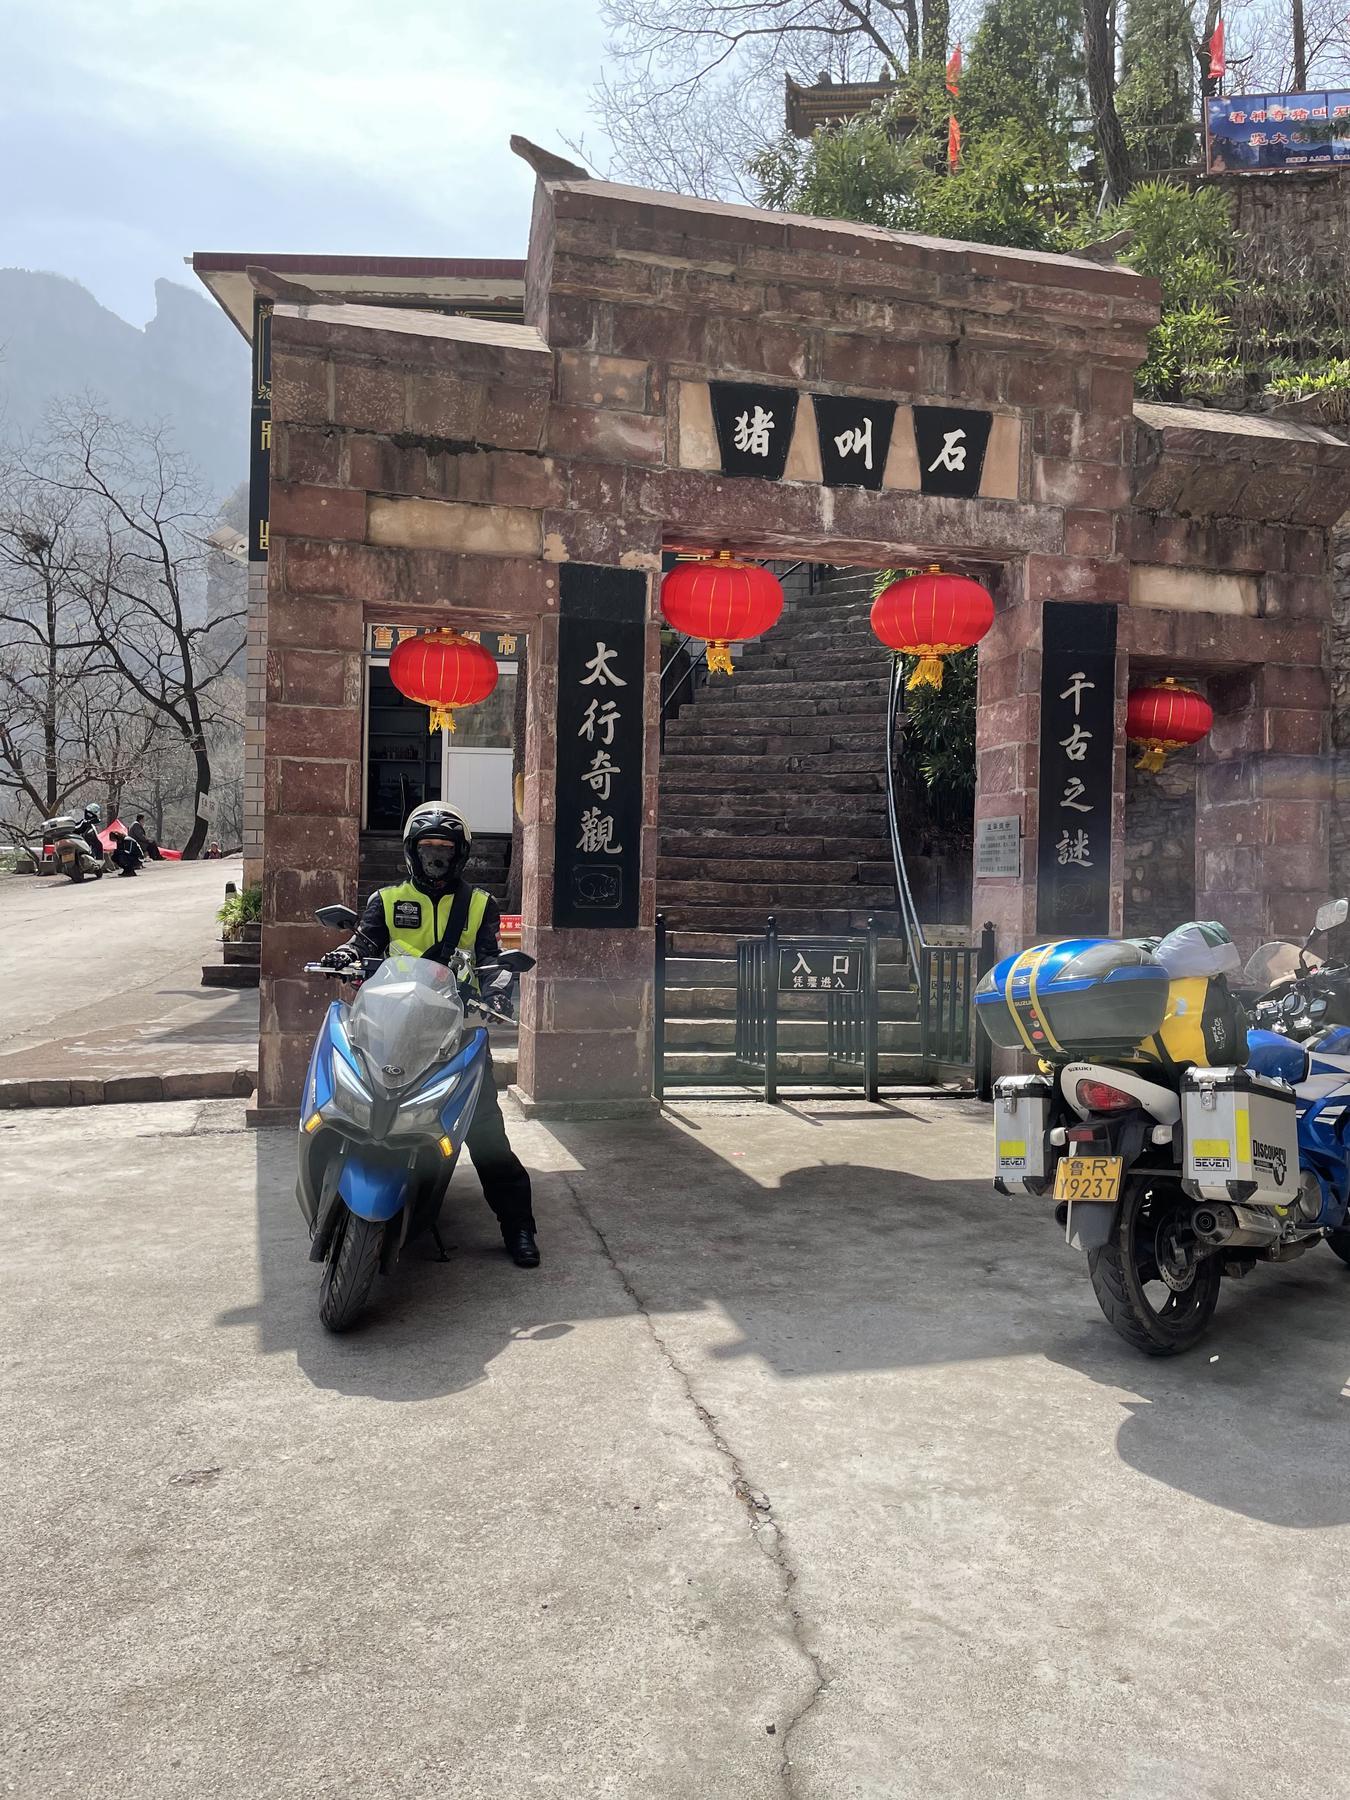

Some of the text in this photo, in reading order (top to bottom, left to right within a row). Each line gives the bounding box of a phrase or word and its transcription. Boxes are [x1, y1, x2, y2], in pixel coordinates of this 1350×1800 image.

[733, 405, 967, 472] 猪叫石
[575, 641, 628, 854] 太行奇觀
[791, 952, 849, 975] 入口
[1060, 1179, 1116, 1198] Y9237
